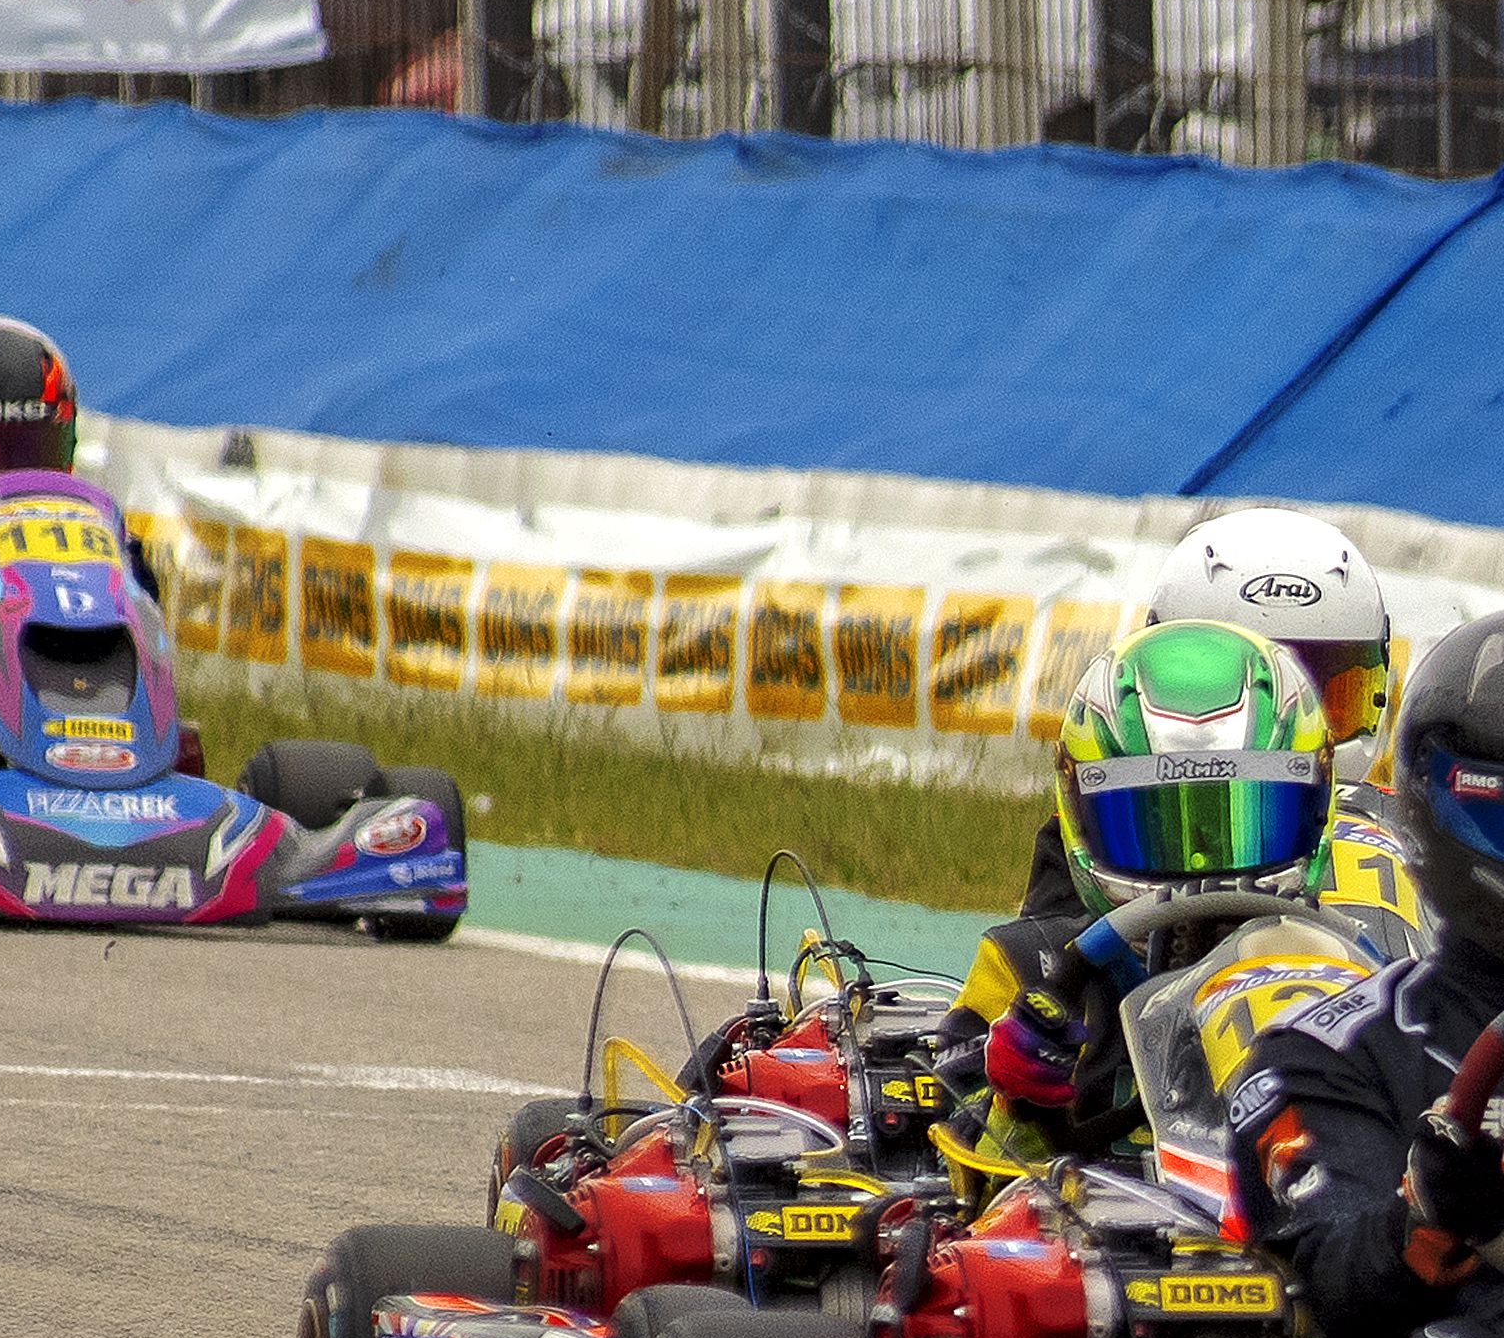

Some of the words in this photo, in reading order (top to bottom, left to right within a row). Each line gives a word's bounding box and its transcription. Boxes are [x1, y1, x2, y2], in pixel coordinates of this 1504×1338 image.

[1250, 577, 1312, 598] Arai
[1156, 754, 1239, 782] Artmix
[23, 862, 195, 909] MEGA
[1314, 994, 1367, 1027] OMP
[1229, 1075, 1276, 1124] OMP
[790, 1212, 860, 1234] DOM
[1168, 1283, 1267, 1305] DOMS
